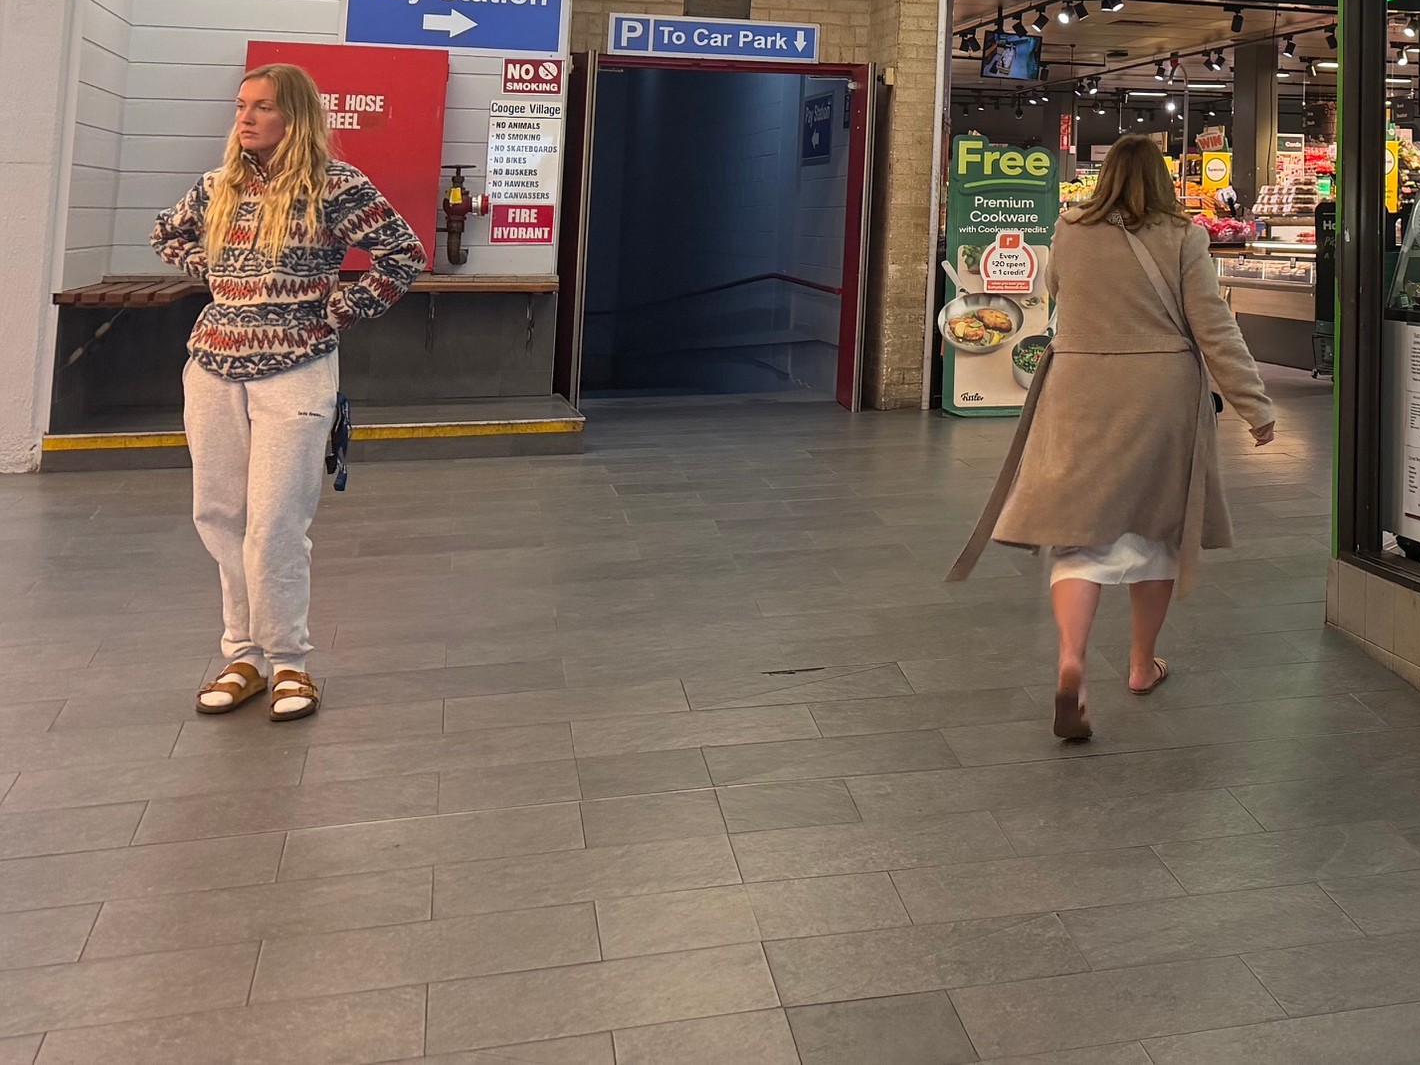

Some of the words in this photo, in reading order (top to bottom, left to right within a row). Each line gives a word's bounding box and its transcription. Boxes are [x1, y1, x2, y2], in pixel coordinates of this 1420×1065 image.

[620, 21, 643, 47] P
[659, 25, 686, 45] To
[692, 28, 733, 49] Car
[738, 30, 788, 51] Park
[507, 63, 534, 80] NO
[505, 82, 558, 92] SMOKING
[320, 94, 339, 110] RE
[345, 95, 384, 112] HOSE
[491, 102, 525, 115] Coogee
[529, 103, 561, 117] Village
[327, 113, 361, 129] REEL
[508, 121, 541, 130] ANIMALS
[507, 133, 541, 141] SMOKING
[1198, 134, 1223, 149] WIN
[506, 144, 557, 153] SKATEBOARDS
[958, 140, 1050, 176] Free
[505, 168, 538, 177] BUSKERS
[504, 180, 539, 188] HAWKERS
[503, 192, 549, 200] CANVASSERS
[974, 196, 1034, 208] Premium
[507, 208, 538, 223] FIRE
[970, 211, 1038, 223] Cookware
[493, 226, 550, 240] HYDRANT
[958, 225, 976, 233] with
[978, 225, 1018, 234] Cookware
